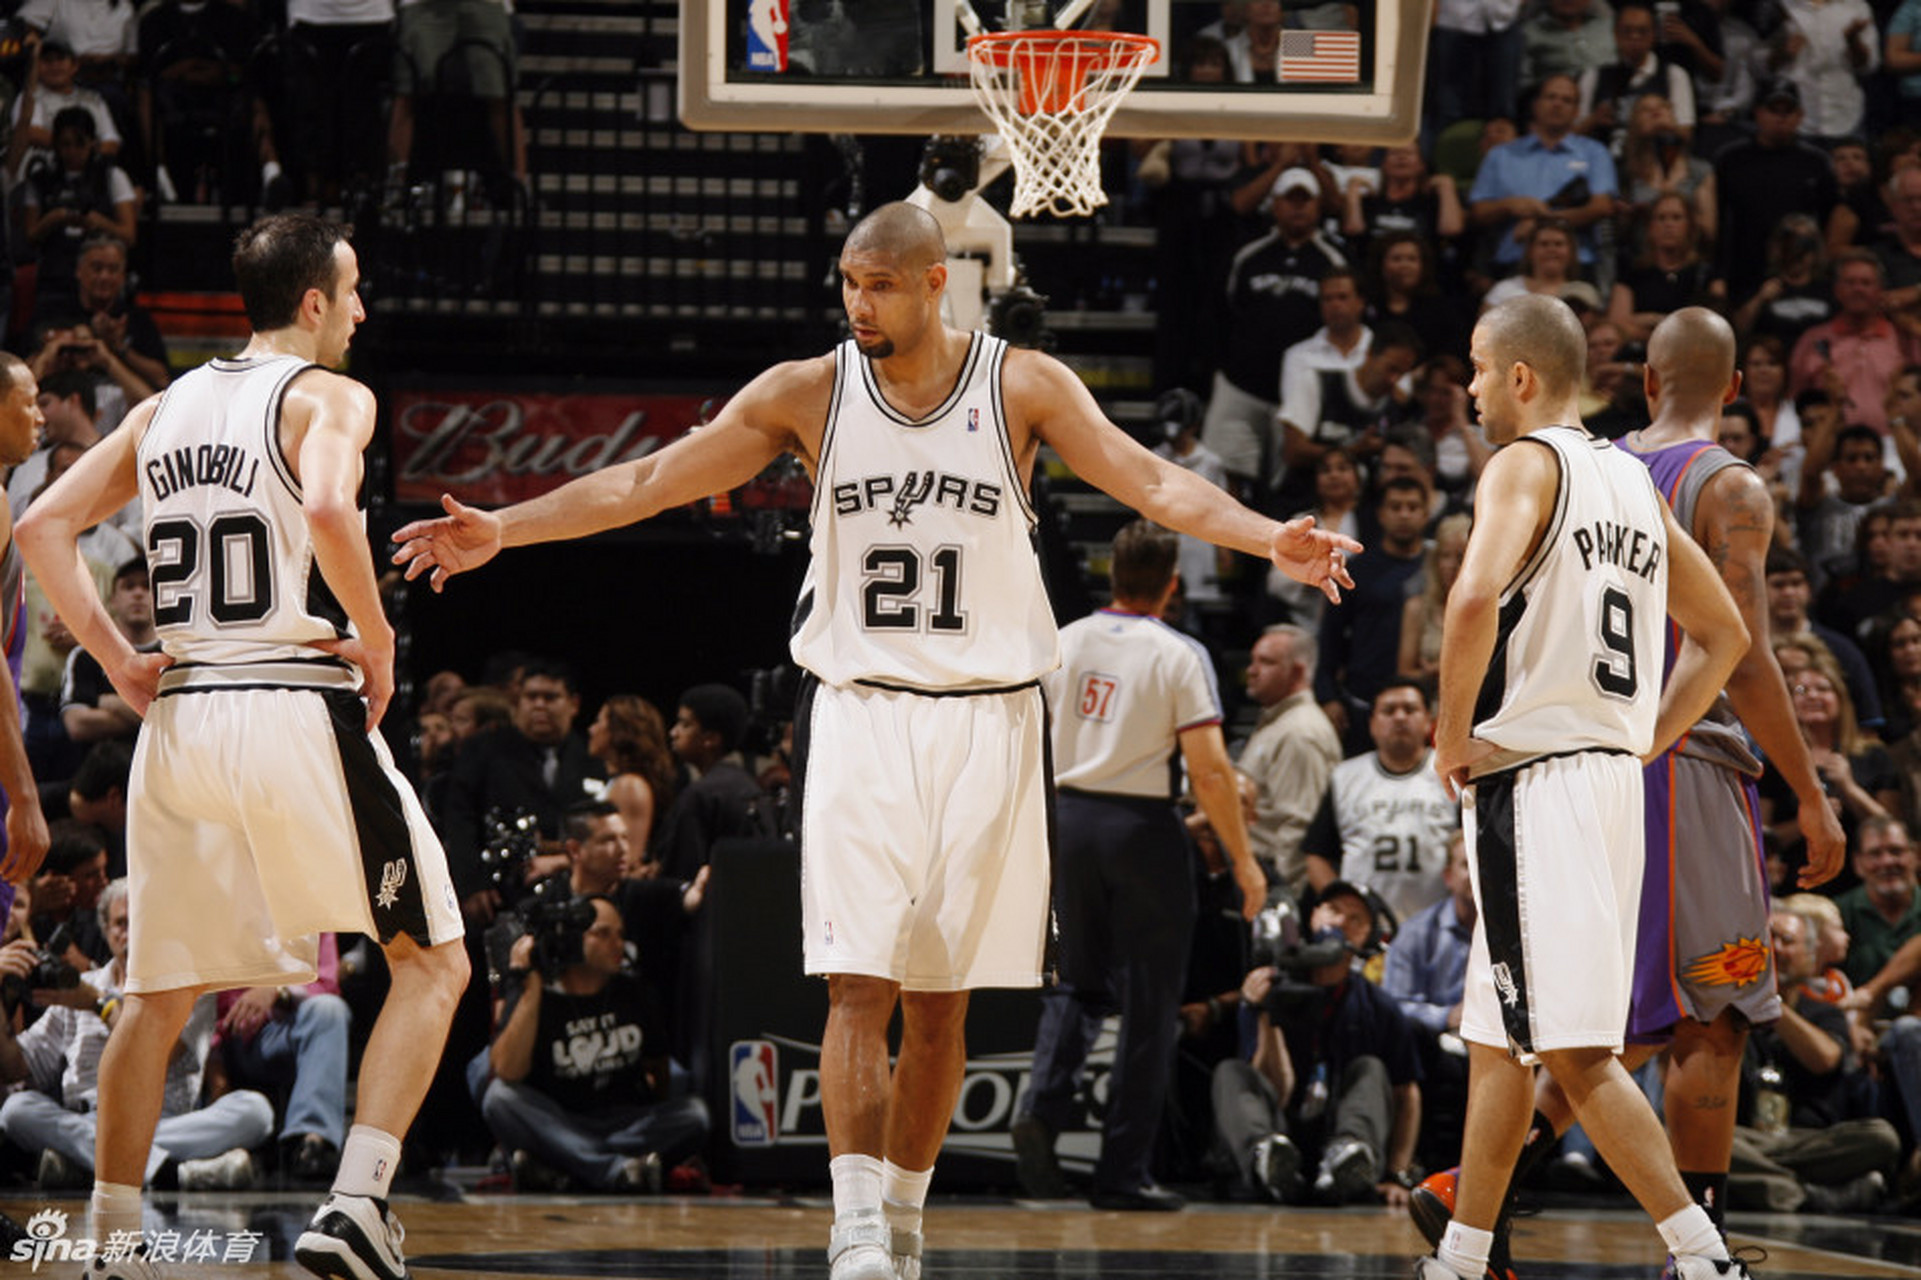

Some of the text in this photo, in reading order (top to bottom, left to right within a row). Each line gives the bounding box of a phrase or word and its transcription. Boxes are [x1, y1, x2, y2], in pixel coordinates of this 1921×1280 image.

[146, 444, 260, 502] GINOBILI
[833, 470, 1002, 530] SPURS
[147, 508, 280, 630] 20
[1573, 521, 1662, 584] PARKER
[860, 544, 968, 636] 21
[1588, 581, 1640, 705] 9
[1082, 678, 1116, 718] 57
[1374, 834, 1422, 873] 21
